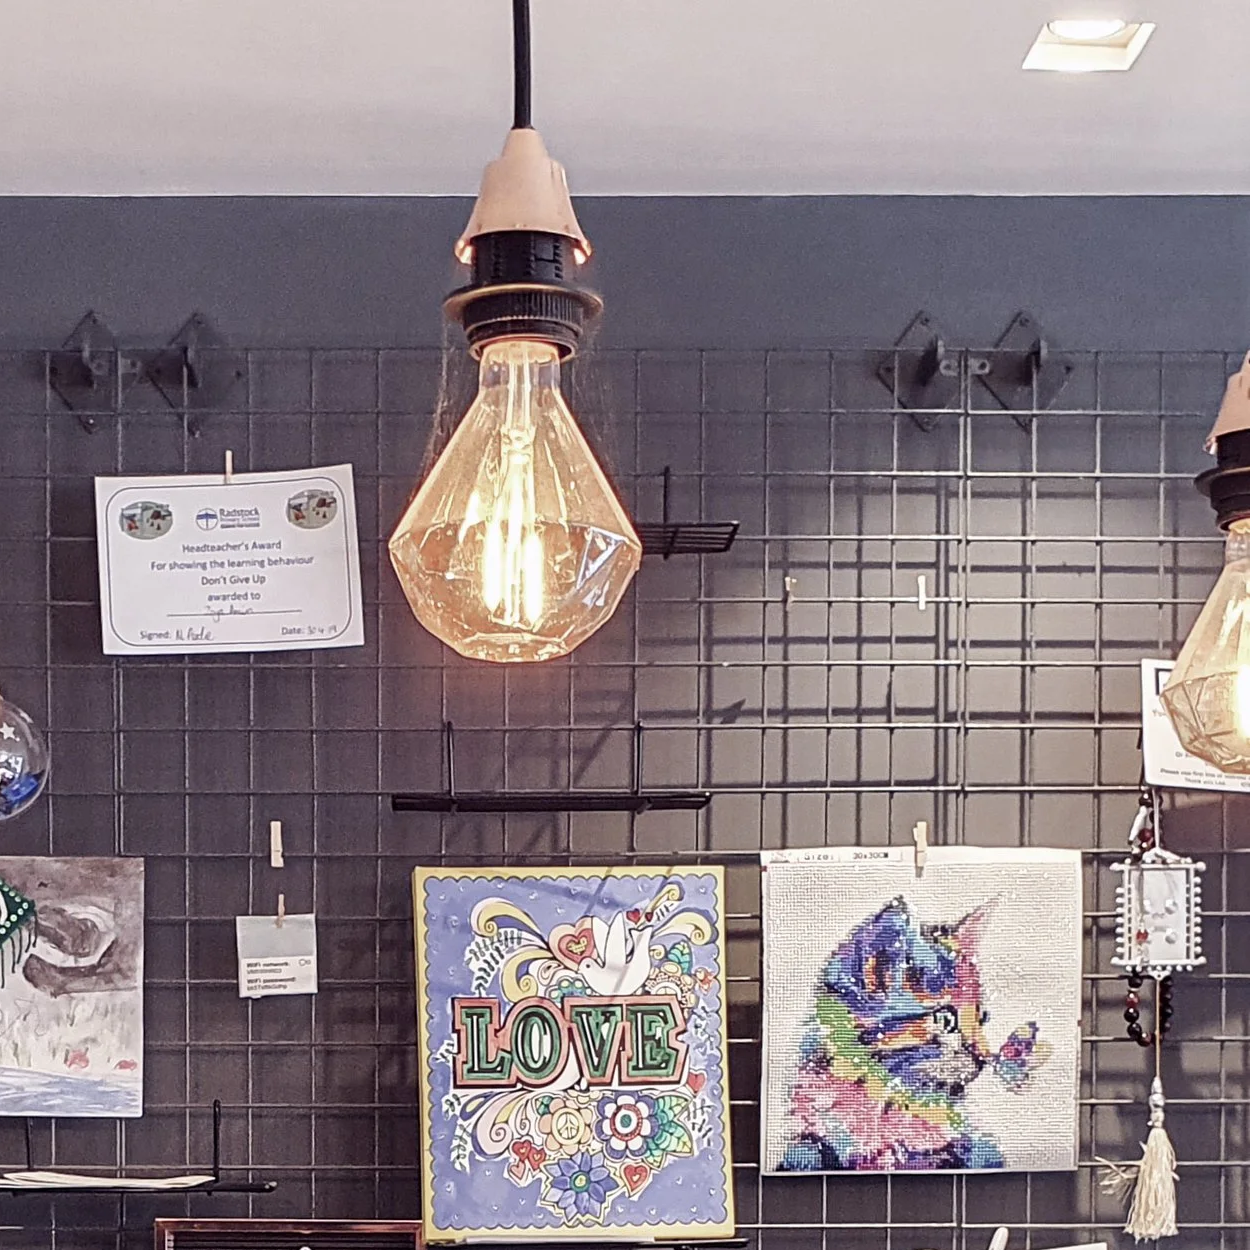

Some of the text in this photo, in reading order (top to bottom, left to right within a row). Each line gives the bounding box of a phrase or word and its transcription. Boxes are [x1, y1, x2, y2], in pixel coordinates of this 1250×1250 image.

[219, 507, 260, 517] Radstock
[182, 540, 281, 553] Headteacher's Award
[151, 556, 314, 571] For showing the learning behaviour
[201, 574, 266, 586] Don't Give Up
[208, 592, 261, 602] awarded to
[456, 999, 687, 1086] LOVE
